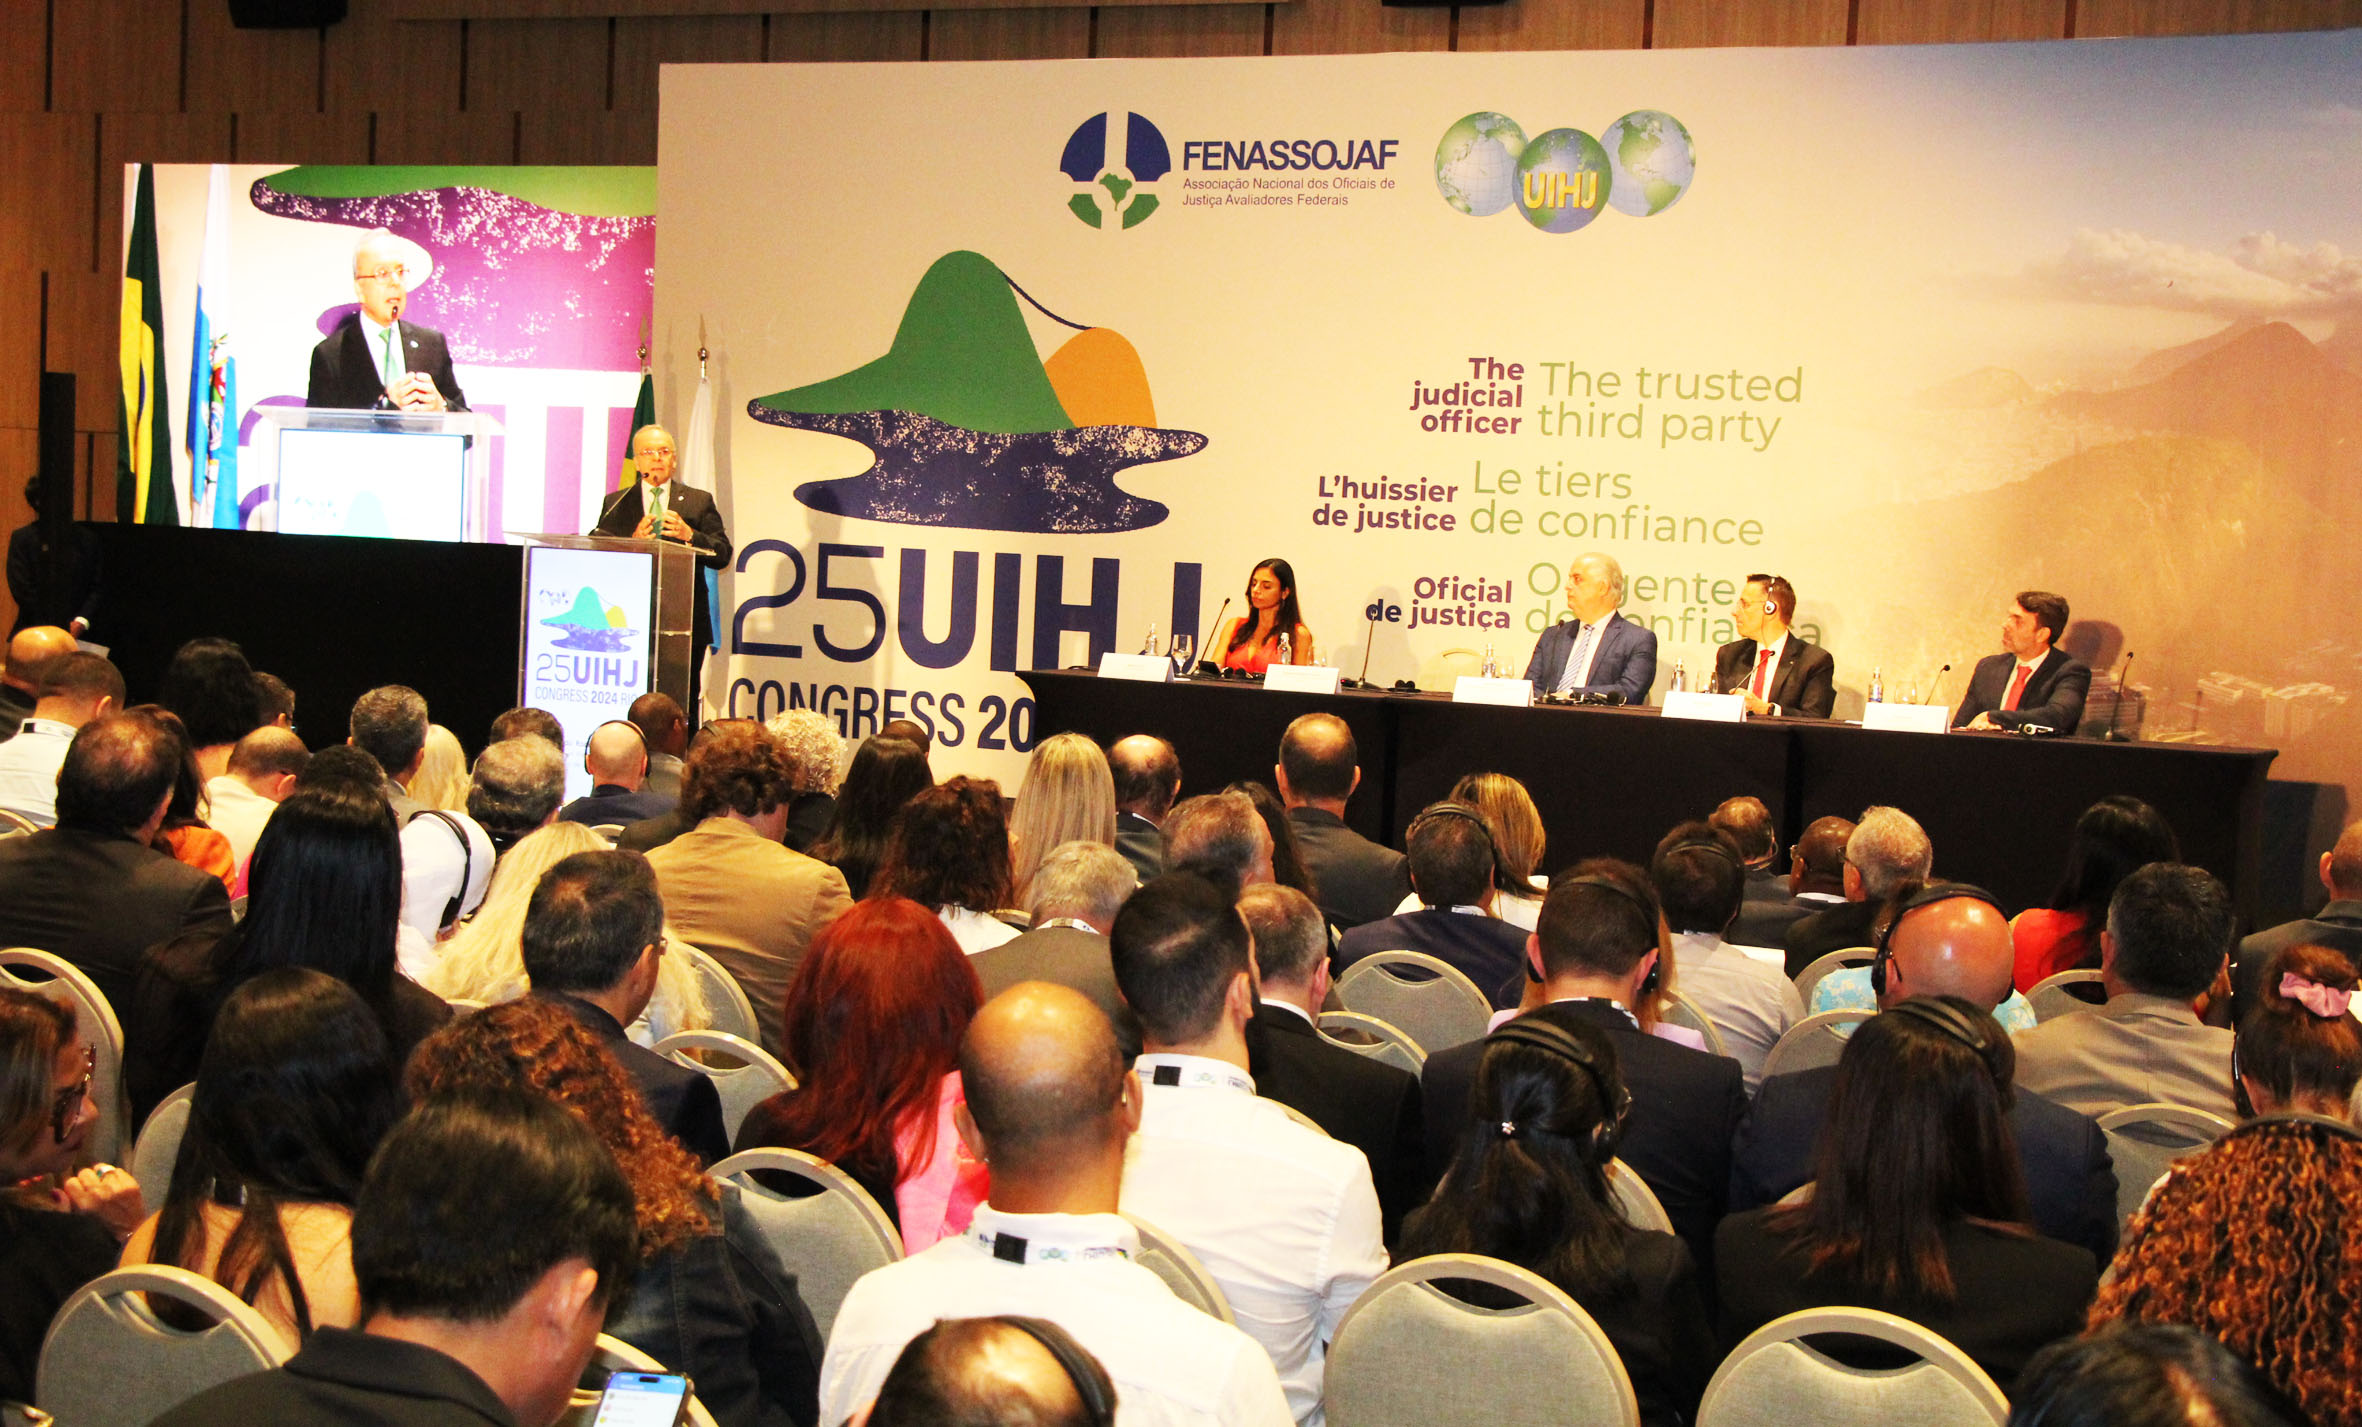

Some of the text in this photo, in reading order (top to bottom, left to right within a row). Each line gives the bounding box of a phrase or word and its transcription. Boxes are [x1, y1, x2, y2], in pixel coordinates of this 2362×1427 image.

[1183, 139, 1399, 171] FENASSOJAF
[1182, 193, 1349, 208] Justiça Avaliadores Federais
[1183, 177, 1396, 191] Associação Nacional dos Oficiais de
[1523, 171, 1598, 209] UIHJ
[1468, 356, 1525, 381] The
[1539, 361, 1803, 402] The trusted
[1410, 380, 1523, 410] judicial
[1420, 409, 1522, 435] officer
[1537, 402, 1783, 452] third party
[1473, 459, 1632, 499] Le tiers
[1312, 502, 1457, 533] de justice
[1470, 499, 1764, 546] de confiance
[1413, 575, 1513, 603] Oficial
[1527, 561, 1561, 597] O
[732, 539, 1202, 674] 25UIHJ
[1365, 598, 1511, 632] de justiça
[536, 652, 639, 688] 25UIHJ
[535, 686, 589, 703] CONGRESS
[591, 690, 618, 704] 2024
